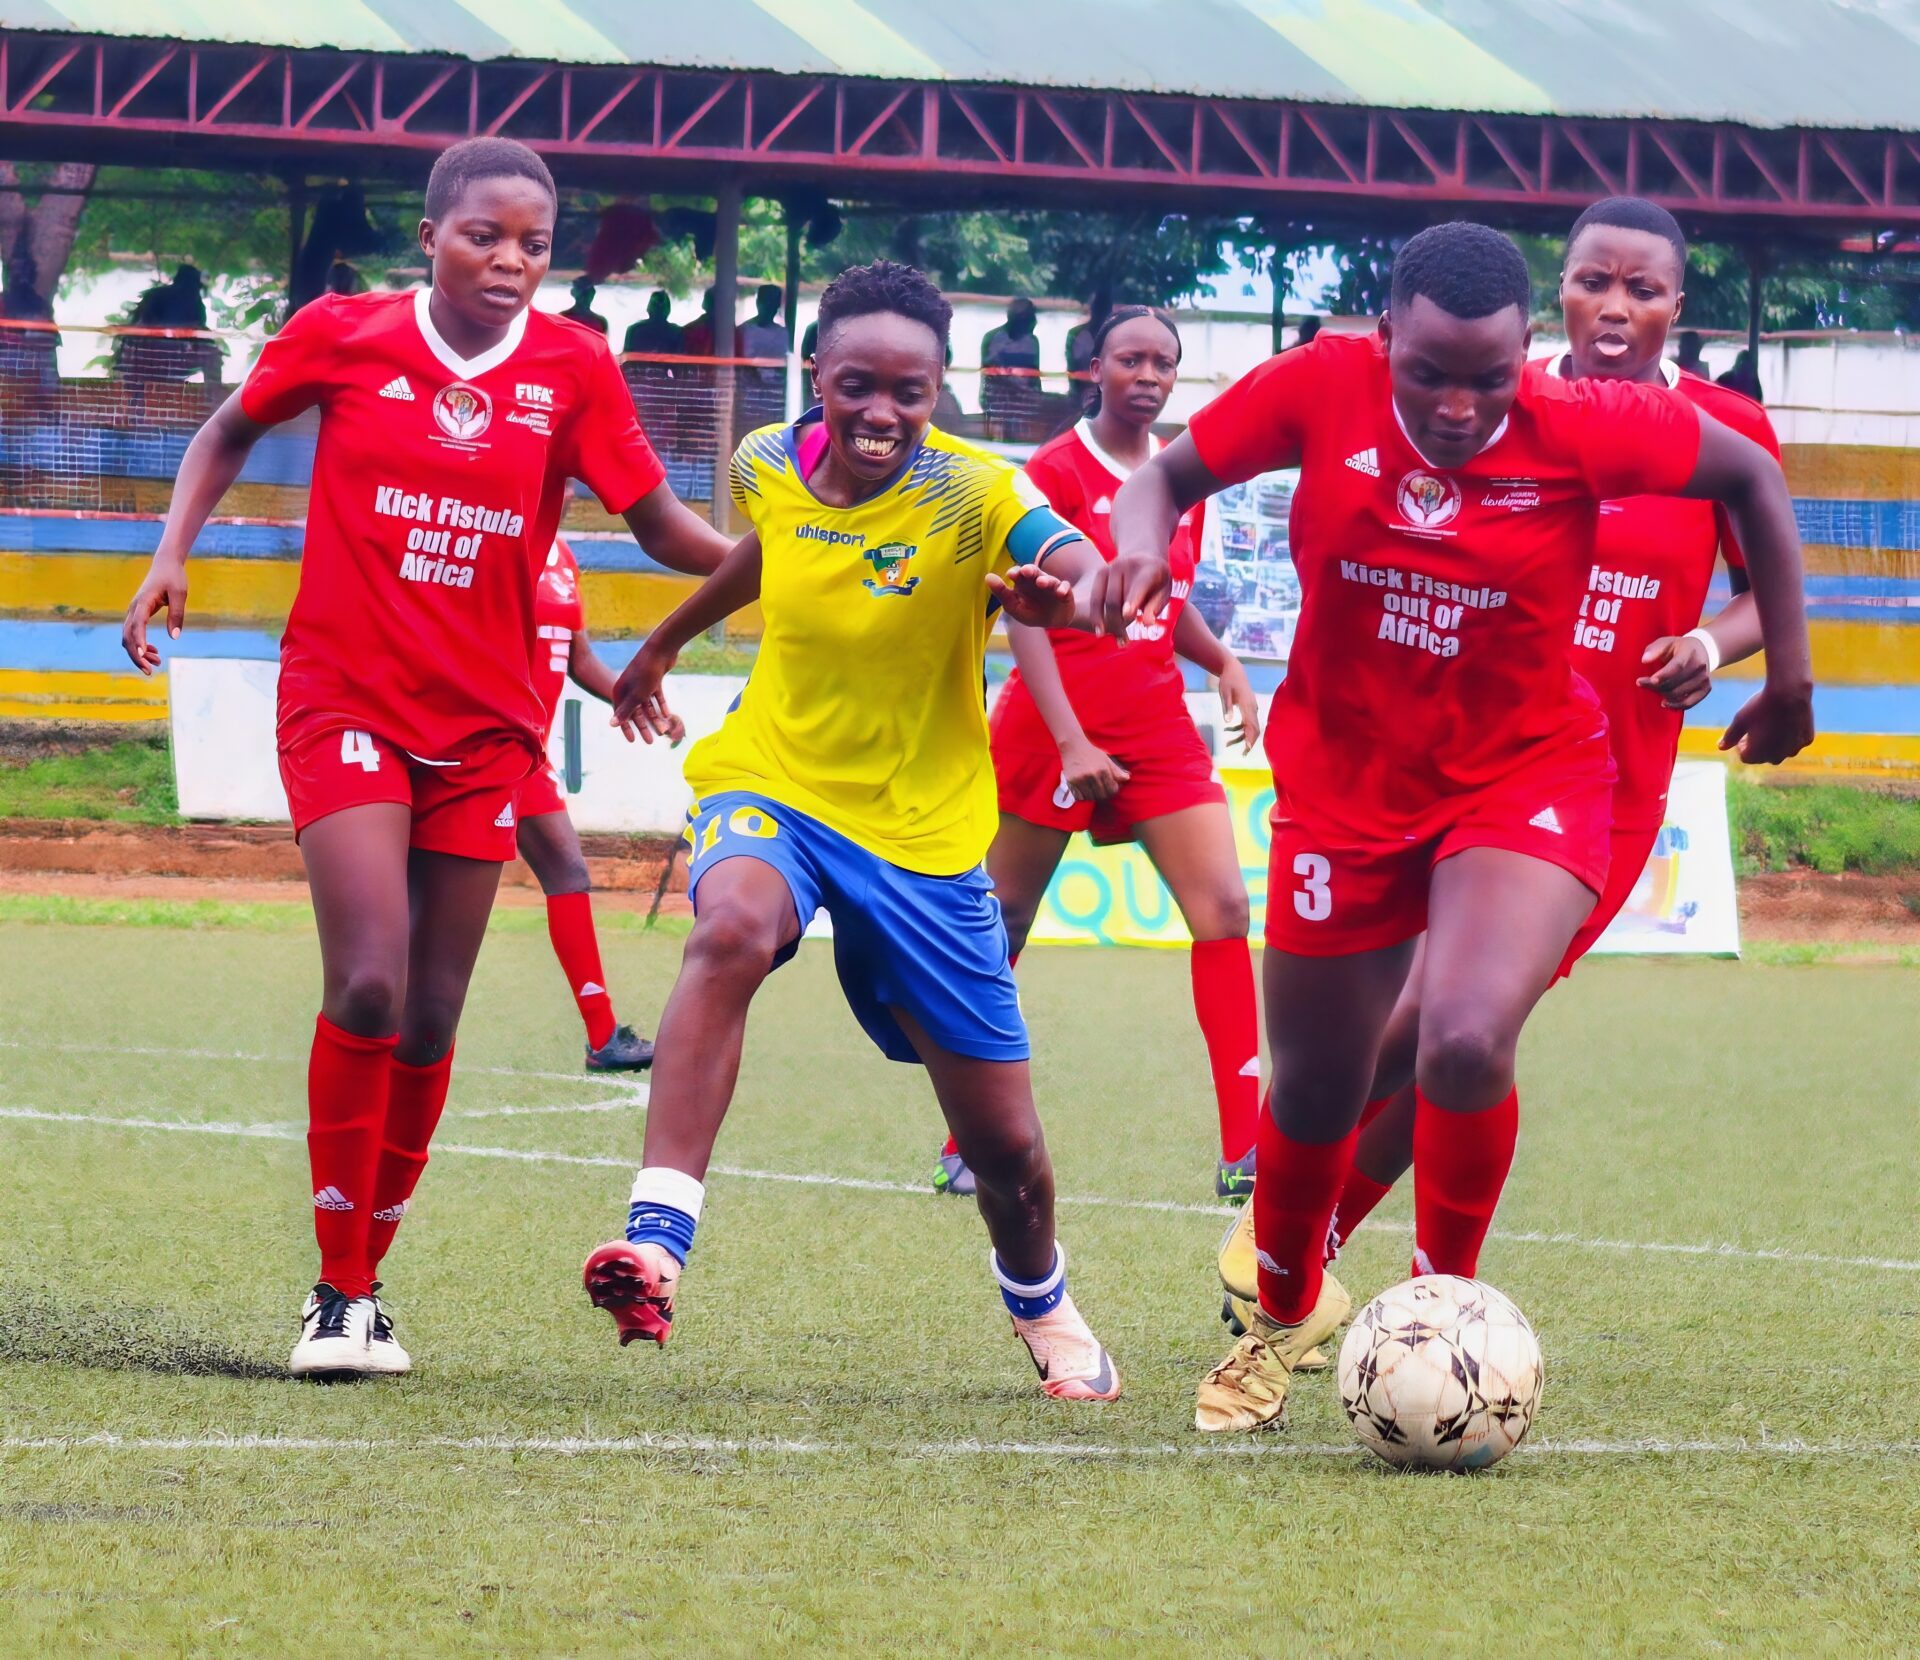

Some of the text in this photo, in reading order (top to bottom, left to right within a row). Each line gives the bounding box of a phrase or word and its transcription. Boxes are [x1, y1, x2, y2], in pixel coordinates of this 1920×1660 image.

[515, 383, 552, 404] FIFA
[1345, 457, 1381, 478] adidas
[375, 485, 524, 537] Kick Fistula
[1481, 493, 1541, 509] development
[407, 527, 483, 560] out of
[795, 523, 866, 547] uhlsport
[399, 552, 474, 588] Africa
[1340, 560, 1507, 609] Kick Fistula
[1588, 565, 1660, 599] istula
[1384, 593, 1464, 630] out of
[1594, 598, 1623, 624] of
[1378, 613, 1459, 657] Africa
[1573, 618, 1615, 653] ica
[341, 730, 380, 772] 4
[1293, 853, 1332, 921] 3
